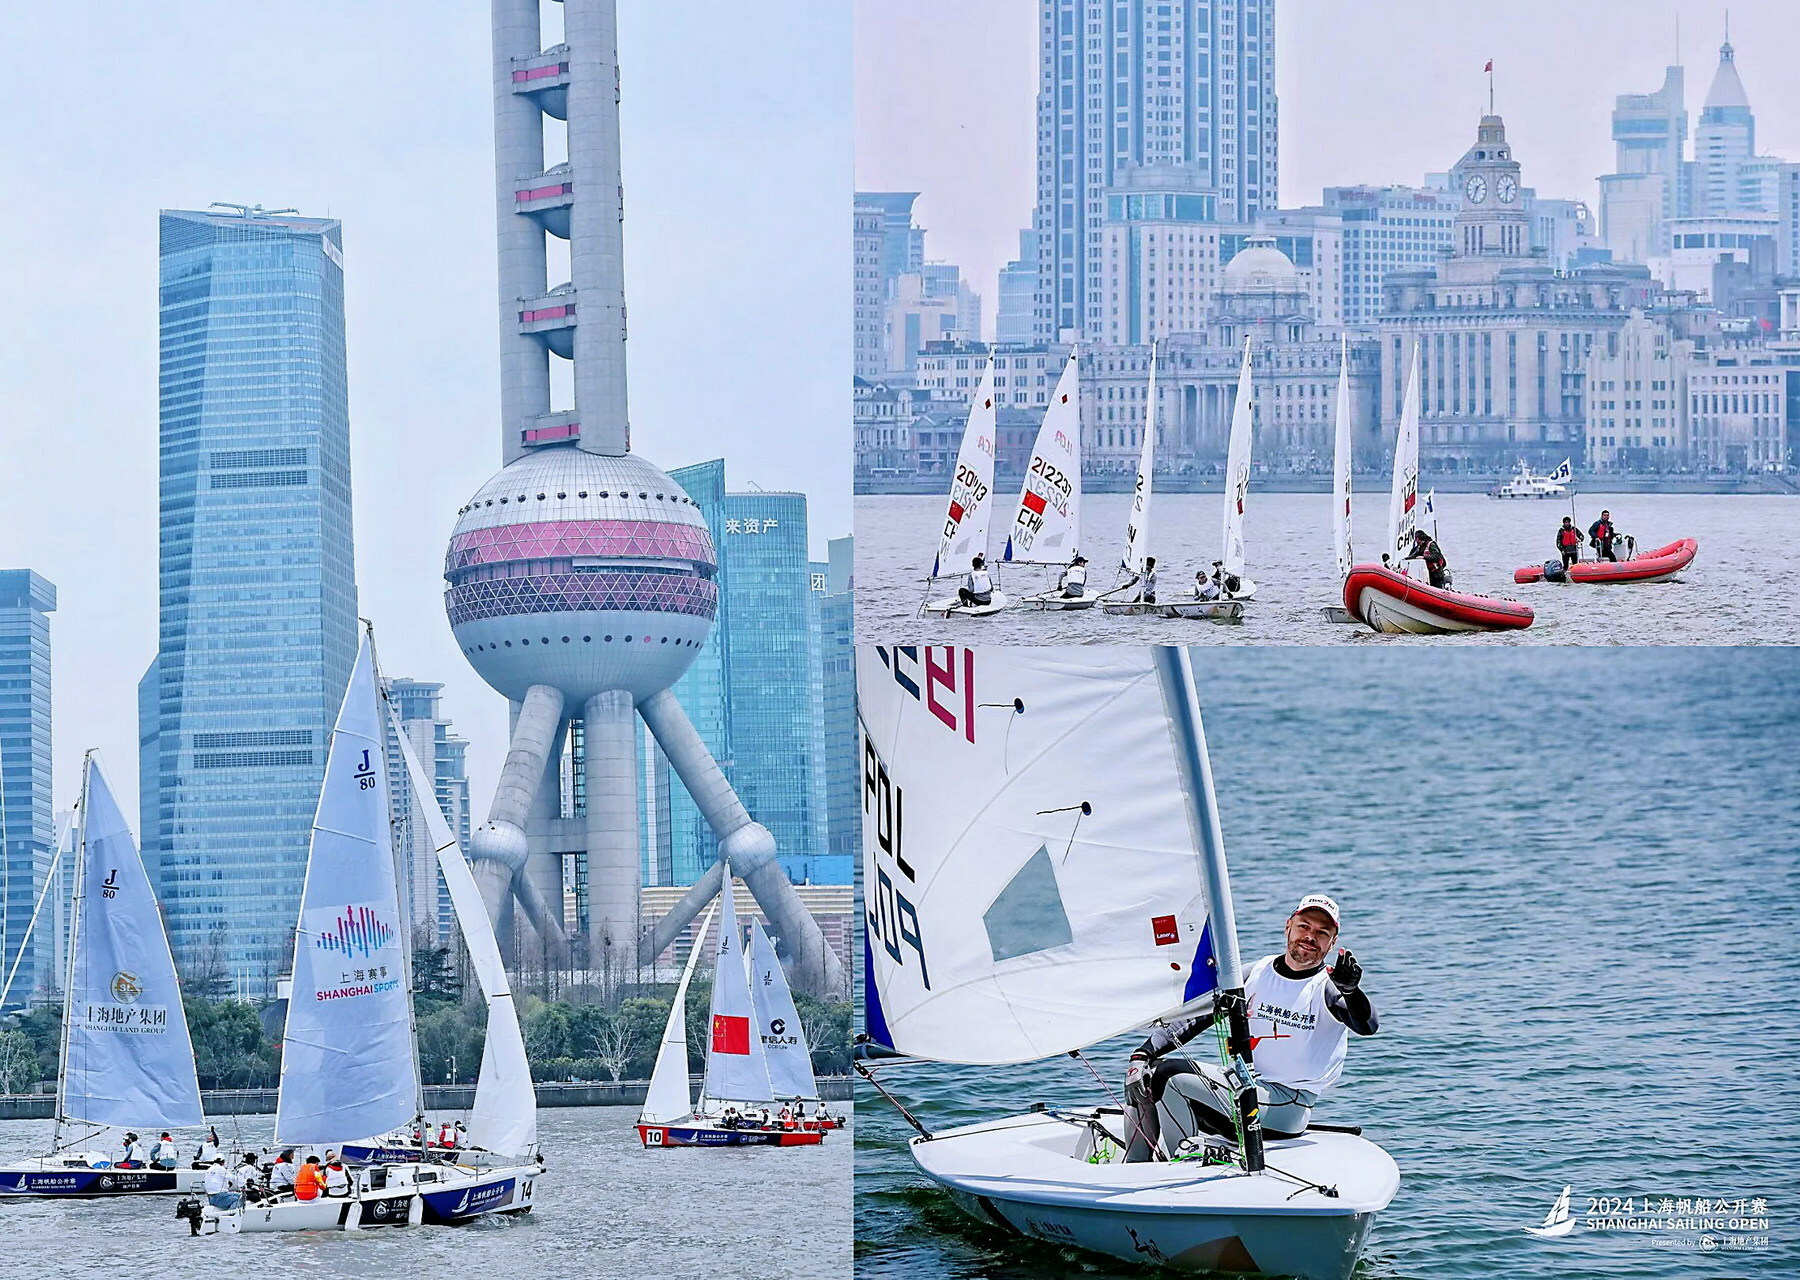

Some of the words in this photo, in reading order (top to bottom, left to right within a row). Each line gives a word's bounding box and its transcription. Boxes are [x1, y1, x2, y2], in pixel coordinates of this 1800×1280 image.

[726, 518, 778, 534] 来资产
[810, 573, 826, 592] 团
[358, 749, 369, 772] J
[360, 776, 375, 791] 80
[865, 733, 915, 885] POL
[104, 869, 118, 885] J
[102, 889, 116, 899] 80
[340, 966, 387, 984] 上海赛事
[88, 1006, 166, 1026] 上海地产集团
[85, 1025, 118, 1033] SHANGHAI
[120, 1026, 139, 1034] LAND
[647, 1131, 661, 1143] 10
[521, 1180, 533, 1201] 14
